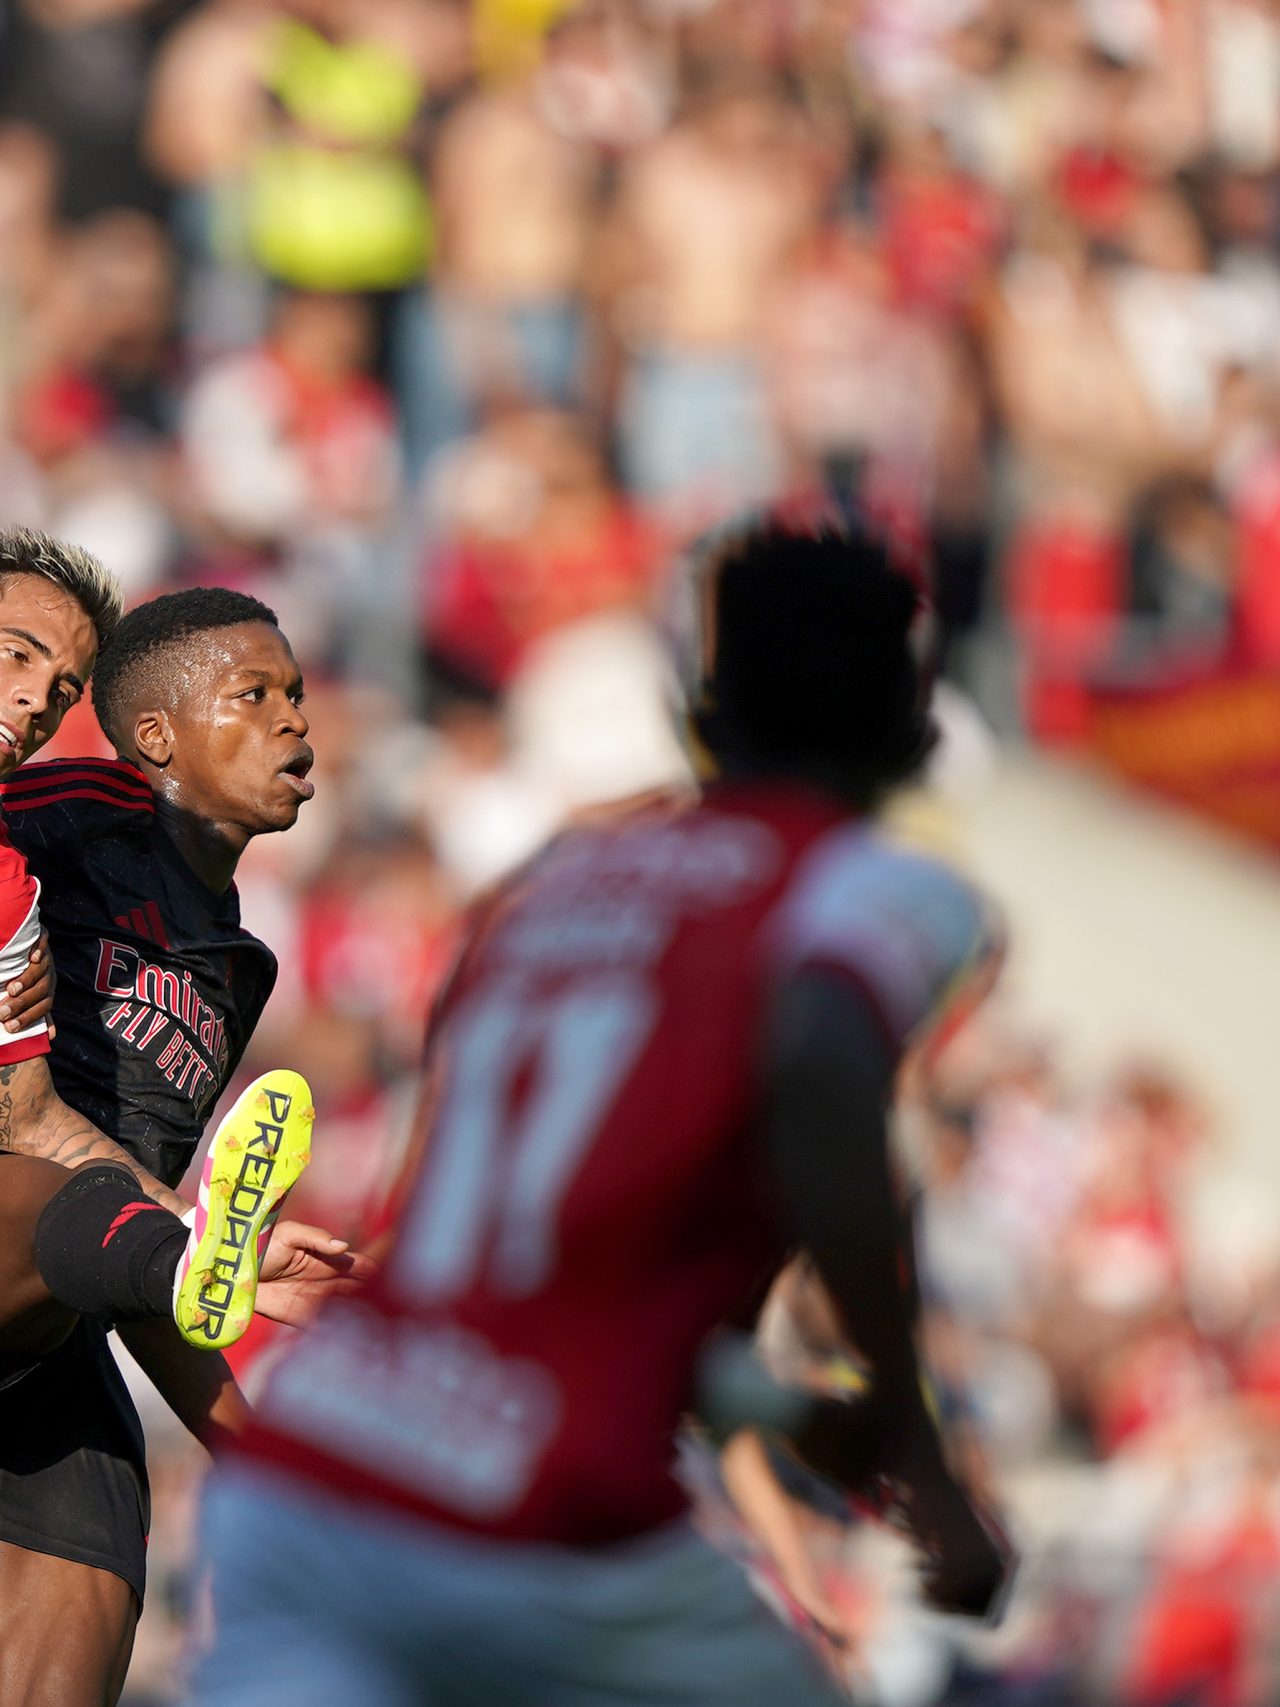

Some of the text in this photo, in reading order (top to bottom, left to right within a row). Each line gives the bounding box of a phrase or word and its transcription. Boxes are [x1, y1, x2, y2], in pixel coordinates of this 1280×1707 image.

[95, 938, 228, 1082] Emirate
[106, 1001, 170, 1051] FLY
[187, 1088, 293, 1341] PREDATOR
